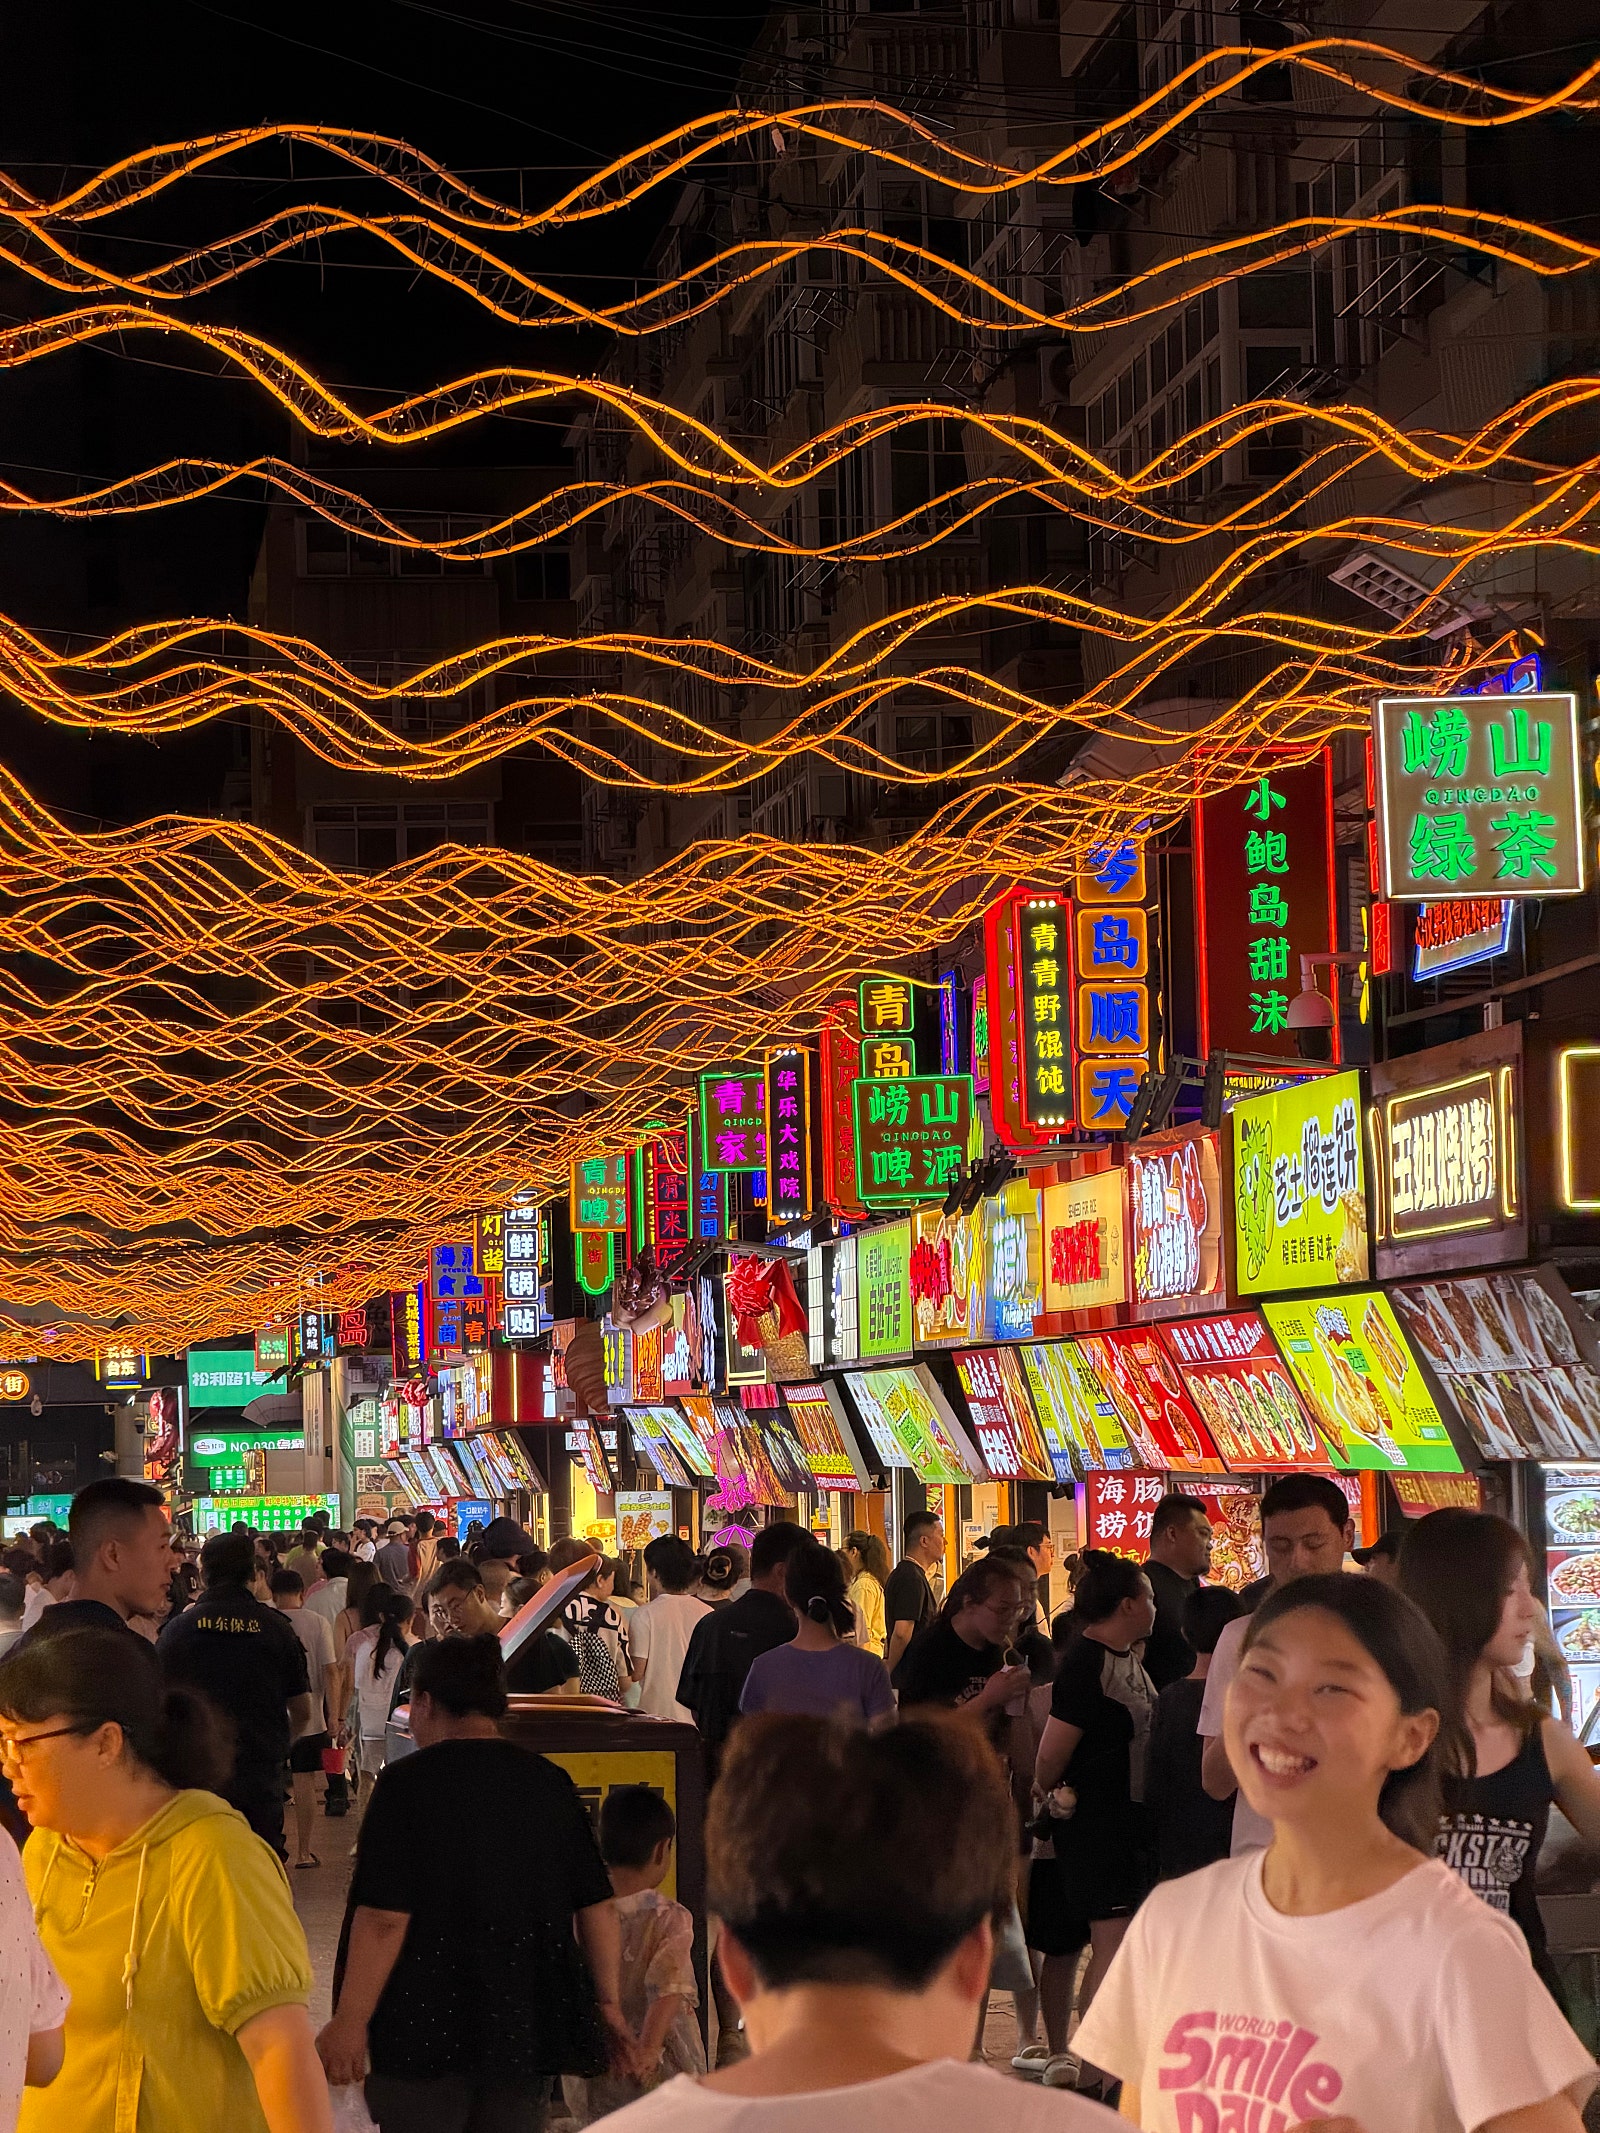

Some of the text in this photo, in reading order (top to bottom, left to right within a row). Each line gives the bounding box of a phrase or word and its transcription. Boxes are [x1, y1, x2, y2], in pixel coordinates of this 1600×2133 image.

[1403, 708, 1551, 779] 崂山
[1426, 786, 1539, 804] QINGDAO
[1410, 811, 1557, 880] 绿茶
[1244, 777, 1290, 1036] 小鲍岛甜沫
[1091, 839, 1142, 1120] 琴岛顺天
[1030, 923, 1065, 1095] 青青野馄饨
[869, 985, 909, 1077] 青岛
[869, 1084, 959, 1127] 崂山
[777, 1070, 801, 1199] 华乐大戏院
[882, 1131, 951, 1142] QINGDAO
[872, 1144, 962, 1187] 啤酒
[1275, 1101, 1357, 1224] 芝士榴莲饼
[438, 1275, 482, 1296] 食品
[0, 1376, 23, 1393] 街
[106, 1360, 136, 1377] 台东
[192, 1371, 284, 1387] 松和路1号
[1096, 1476, 1164, 1504] 海肠
[1218, 2014, 1276, 2036] WORLD
[1159, 2011, 1343, 2122] Smile
